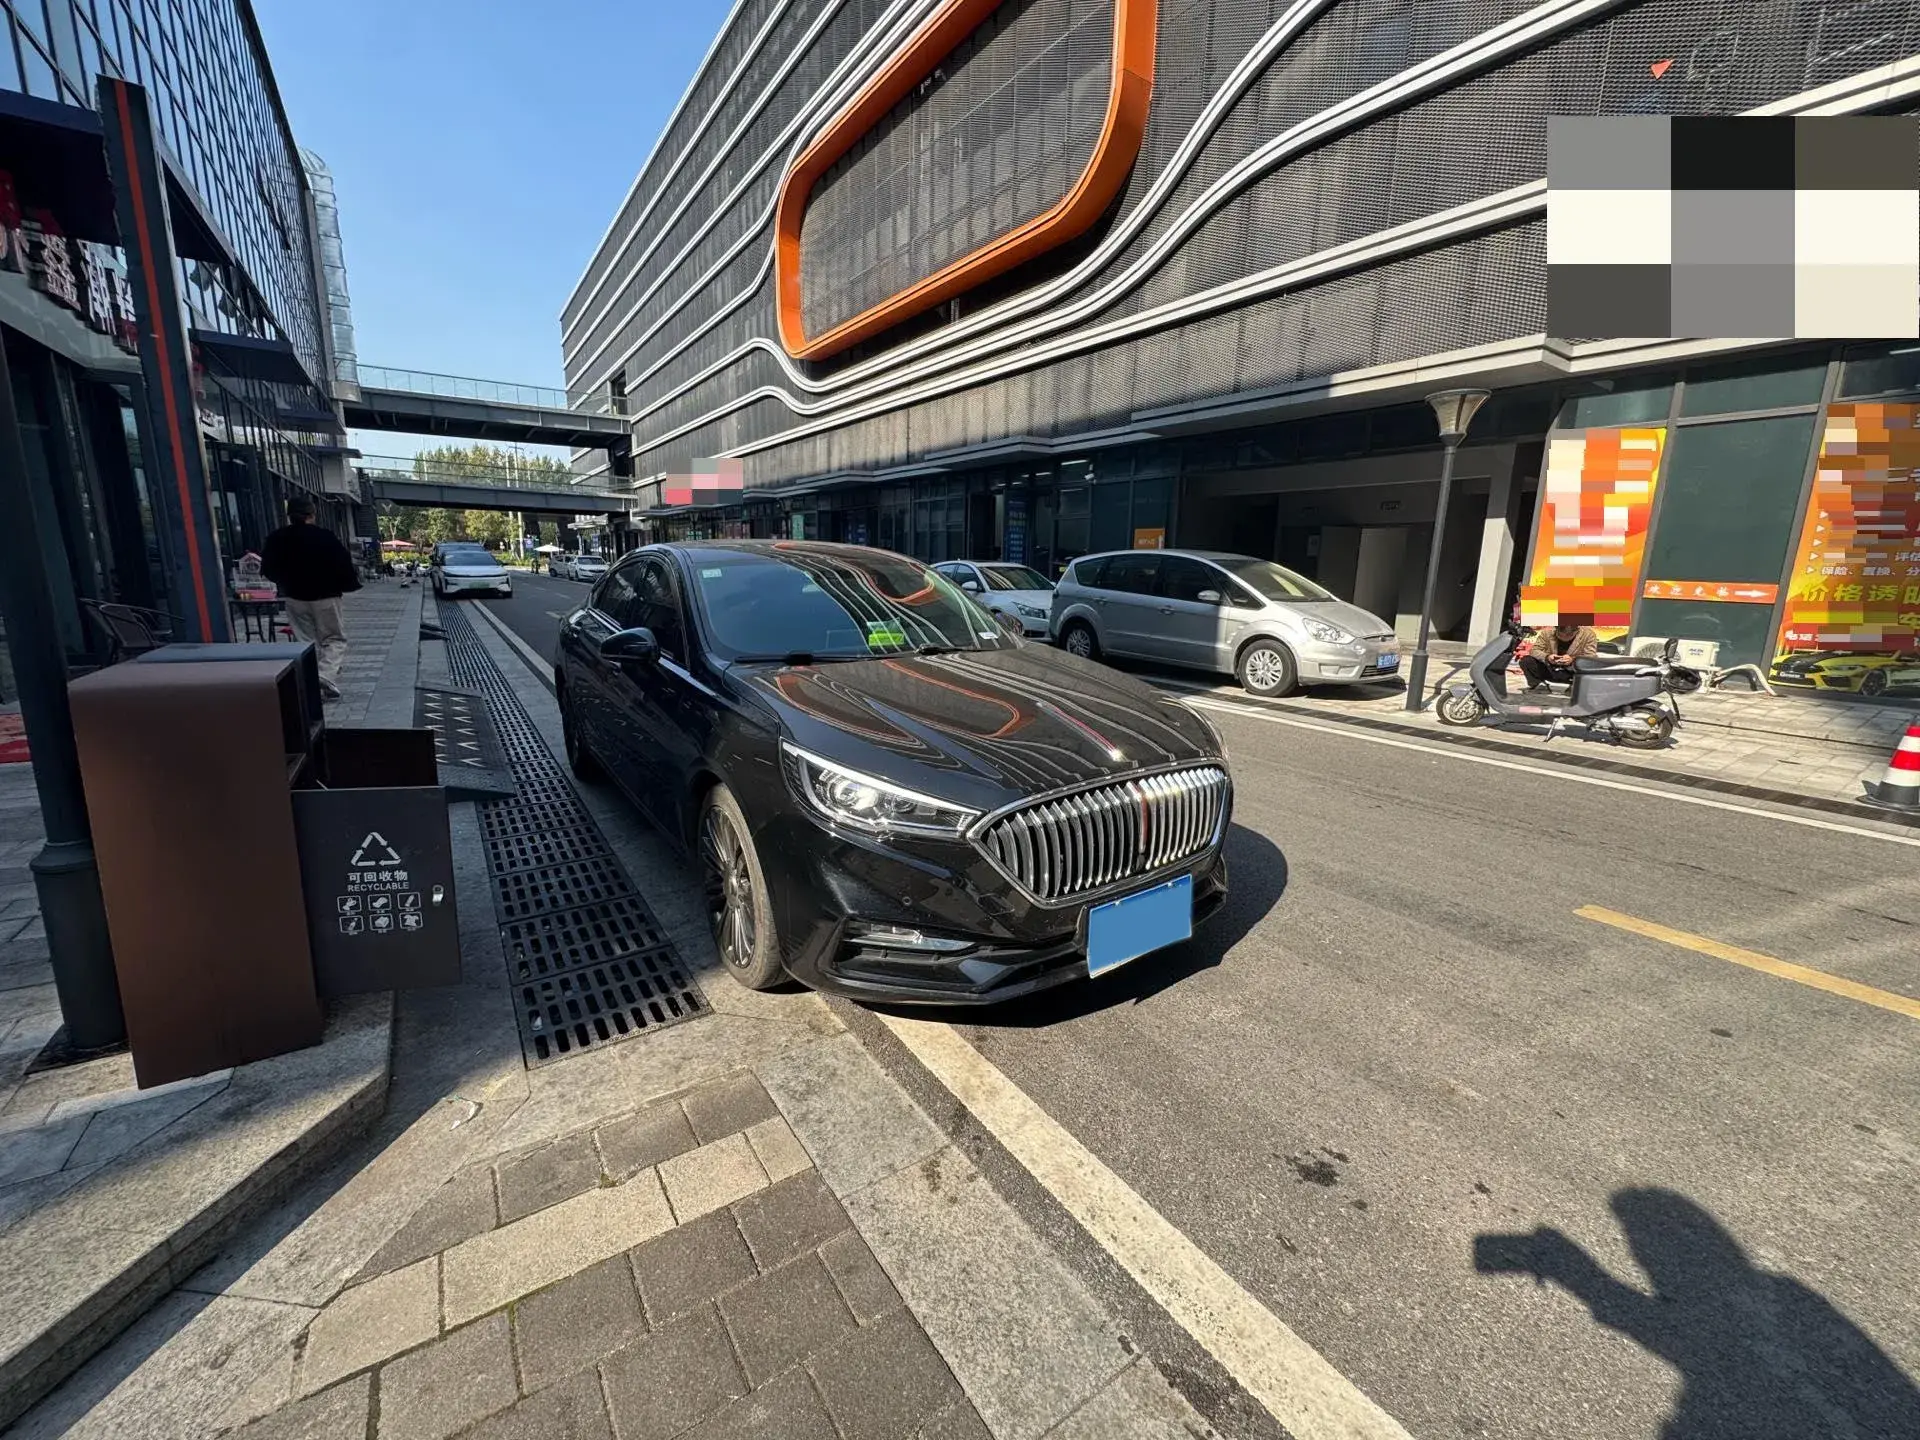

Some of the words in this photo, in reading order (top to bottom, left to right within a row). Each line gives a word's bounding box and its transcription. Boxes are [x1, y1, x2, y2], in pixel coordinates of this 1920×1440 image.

[348, 870, 408, 883] 可回收物
[348, 882, 409, 892] RECYCLABLE
